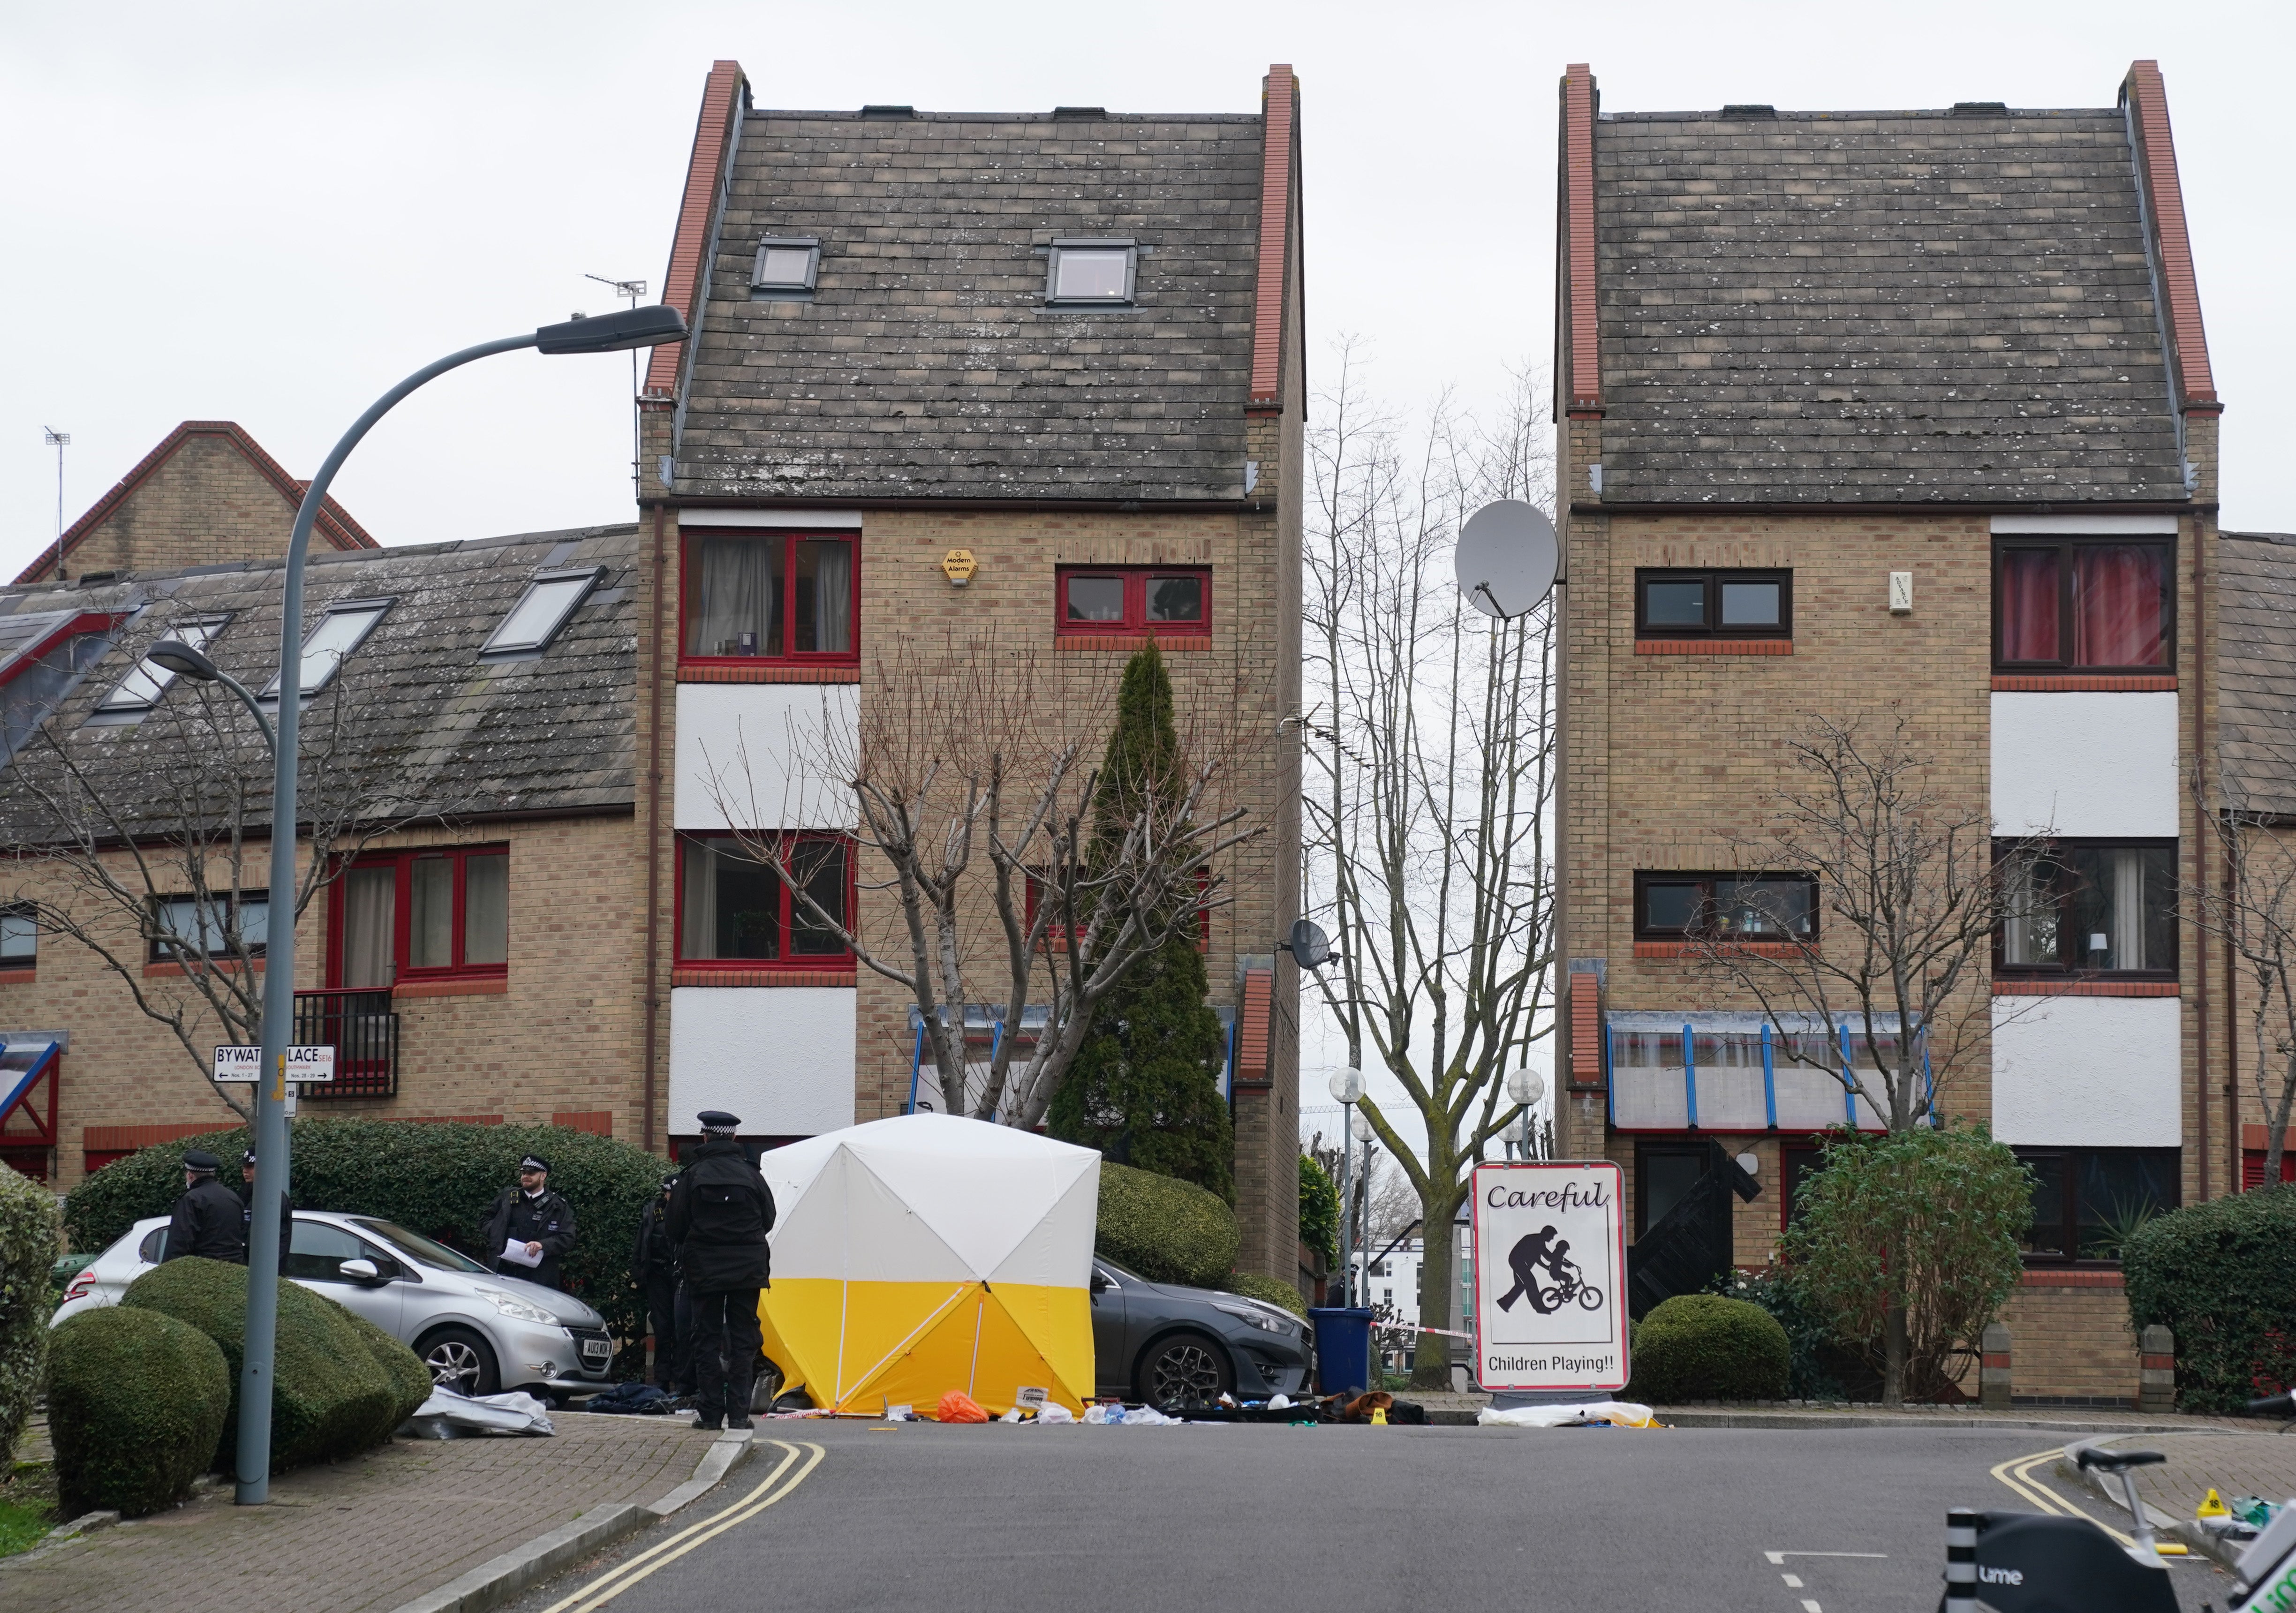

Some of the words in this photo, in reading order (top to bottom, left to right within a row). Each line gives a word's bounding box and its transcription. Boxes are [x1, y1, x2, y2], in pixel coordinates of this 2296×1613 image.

[1895, 576, 1909, 604] ADVANCE
[218, 1049, 260, 1062] BYWAT
[287, 1048, 318, 1062] LACE
[1488, 1181, 1611, 1214] Careful
[1488, 1356, 1547, 1371] Children
[1552, 1355, 1614, 1373] Playing!!
[2209, 1500, 2220, 1509] 18
